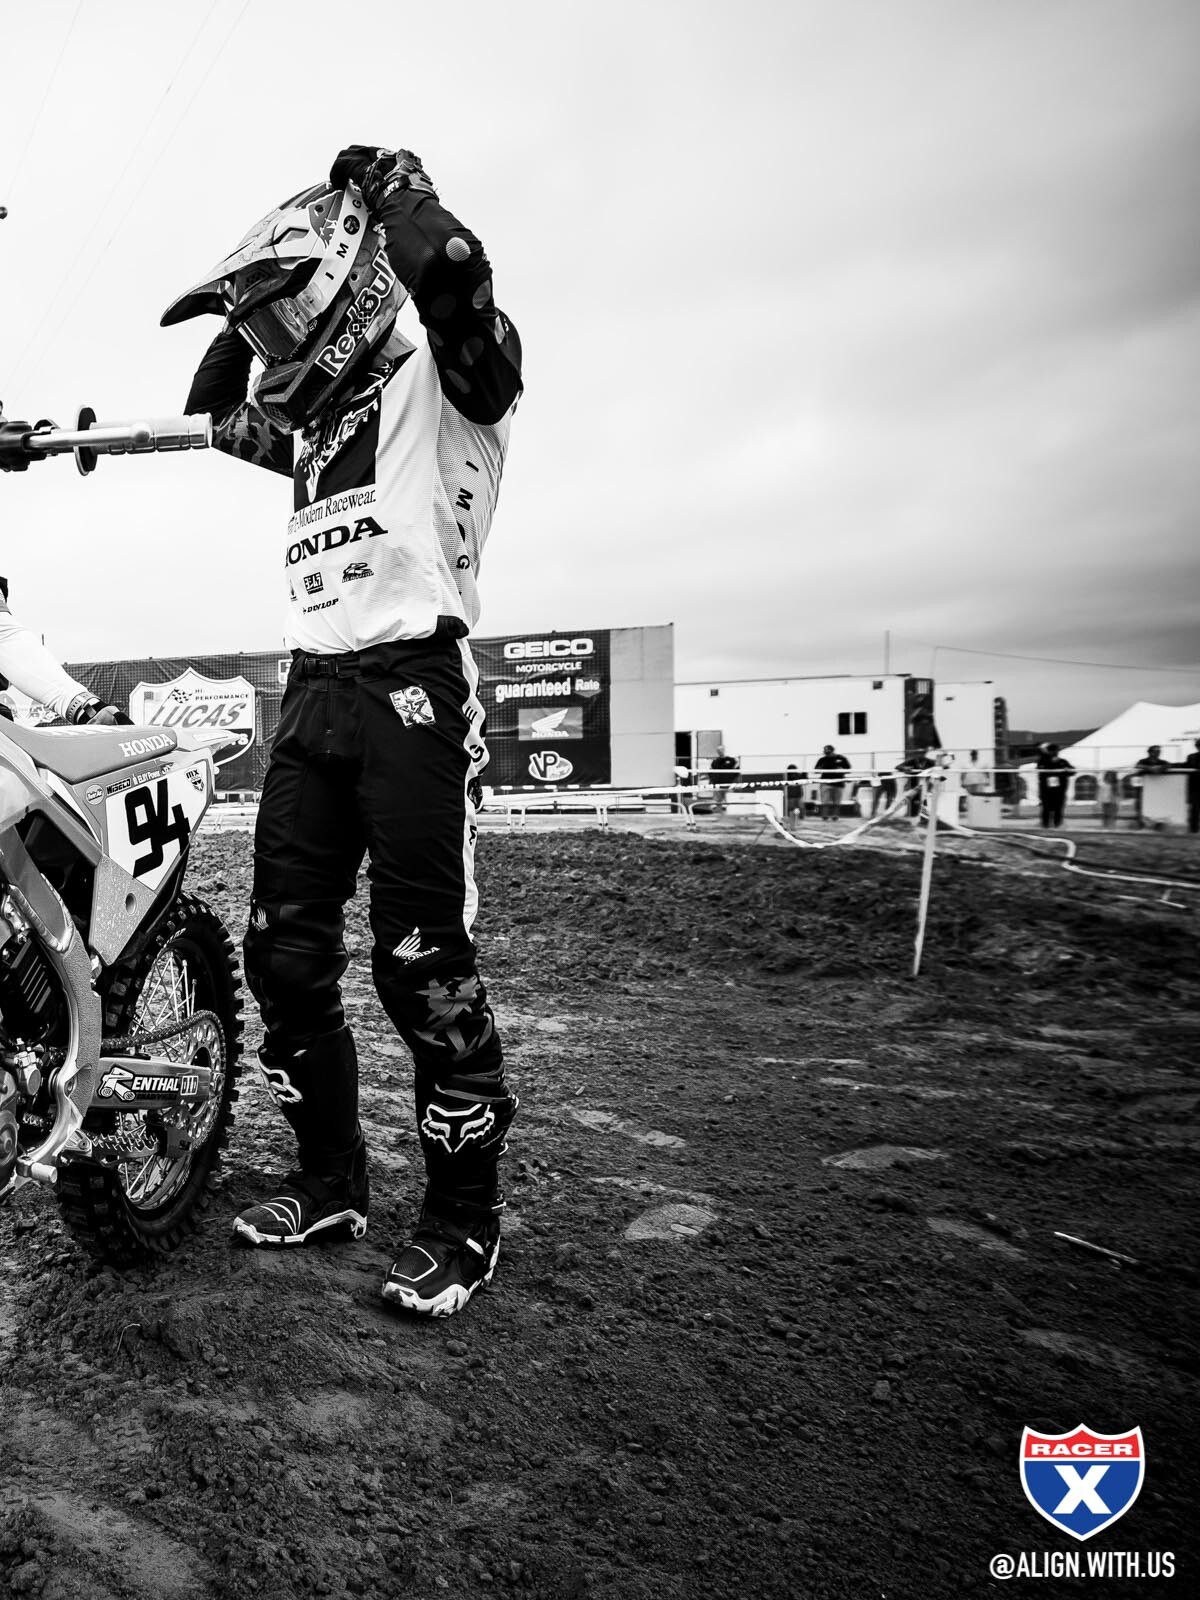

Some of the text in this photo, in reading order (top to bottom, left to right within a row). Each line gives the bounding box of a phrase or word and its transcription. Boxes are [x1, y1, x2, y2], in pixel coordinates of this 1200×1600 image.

[325, 489, 377, 517] Racewear.
[307, 598, 339, 613] DUNLOP
[504, 638, 594, 659] GEICO
[516, 661, 582, 673] MOTORCYCLE
[195, 693, 249, 701] PERFORMANCE
[495, 677, 600, 703] guaranteed Rate
[148, 702, 247, 728] LUCAS
[118, 734, 175, 757] HONDA
[124, 779, 191, 878] 94
[99, 1066, 179, 1101] RENTHAL
